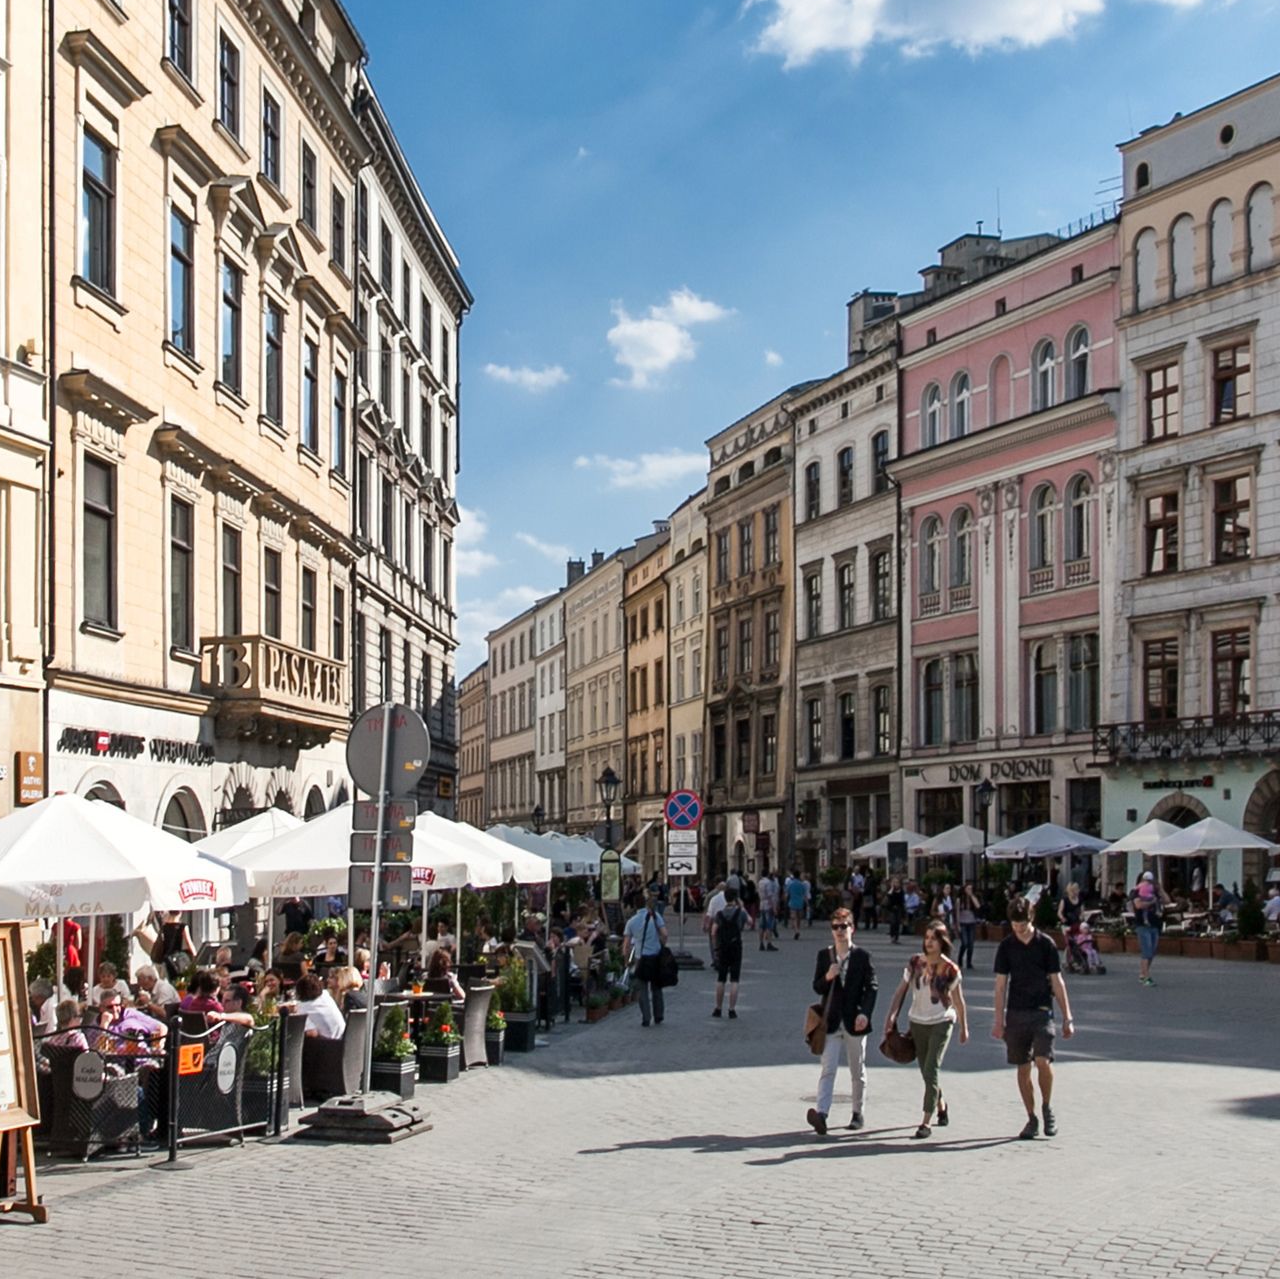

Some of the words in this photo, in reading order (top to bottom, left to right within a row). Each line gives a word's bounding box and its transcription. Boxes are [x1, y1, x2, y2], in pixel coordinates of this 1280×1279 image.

[948, 763, 981, 783] DOM
[990, 758, 1053, 780] POLONII
[271, 884, 327, 895] MALAGA
[24, 902, 105, 916] MALAGA
